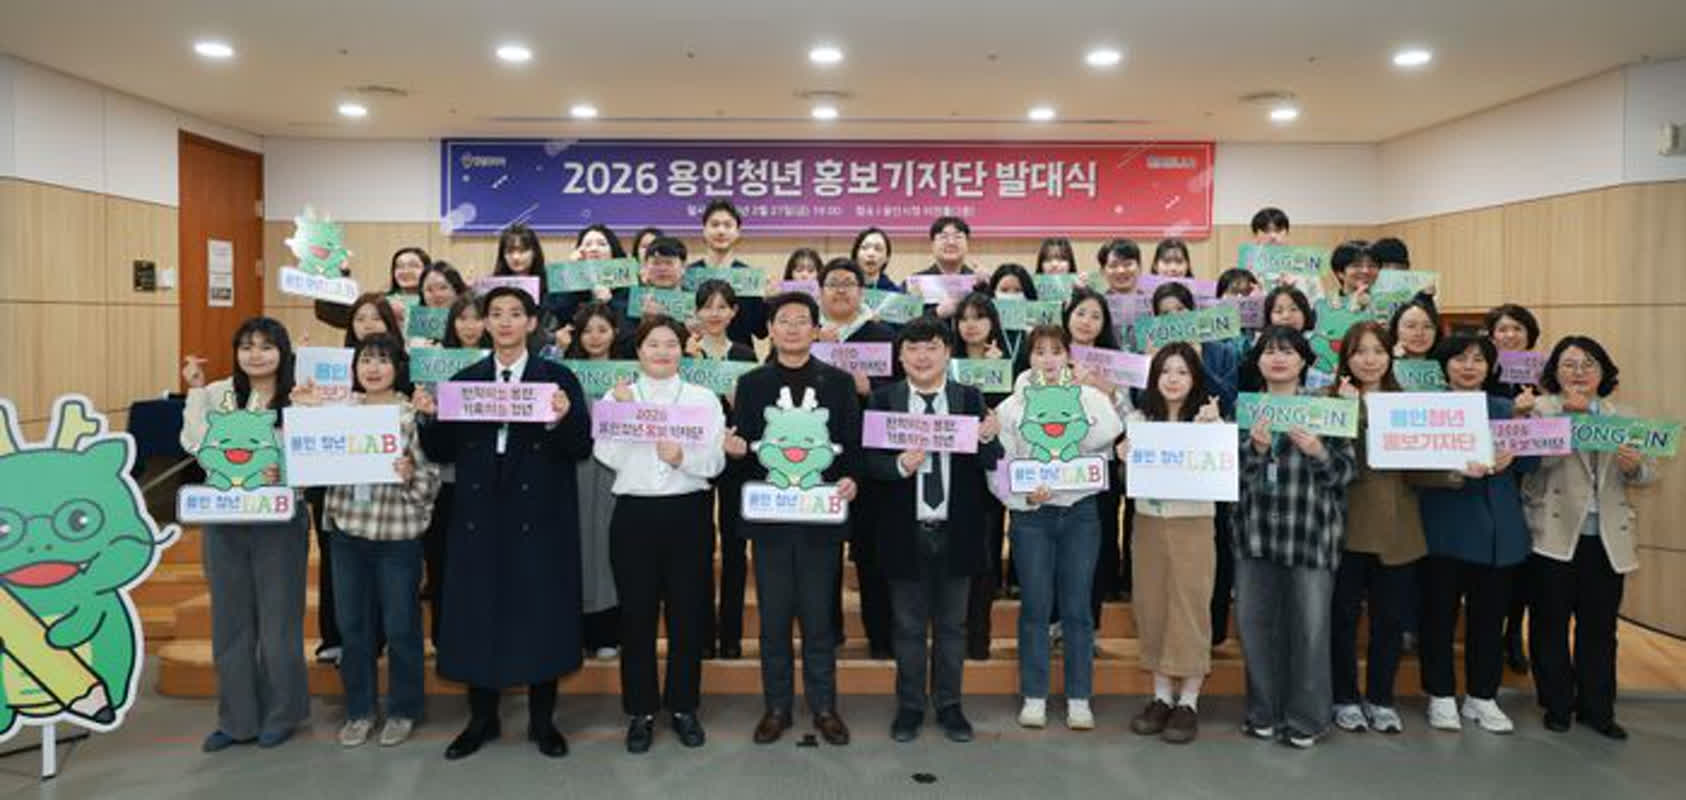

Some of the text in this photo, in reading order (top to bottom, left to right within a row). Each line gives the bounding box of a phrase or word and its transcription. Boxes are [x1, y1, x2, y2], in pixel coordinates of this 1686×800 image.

[563, 159, 1098, 198] 2026 용인청년 홍보기자단 발대식
